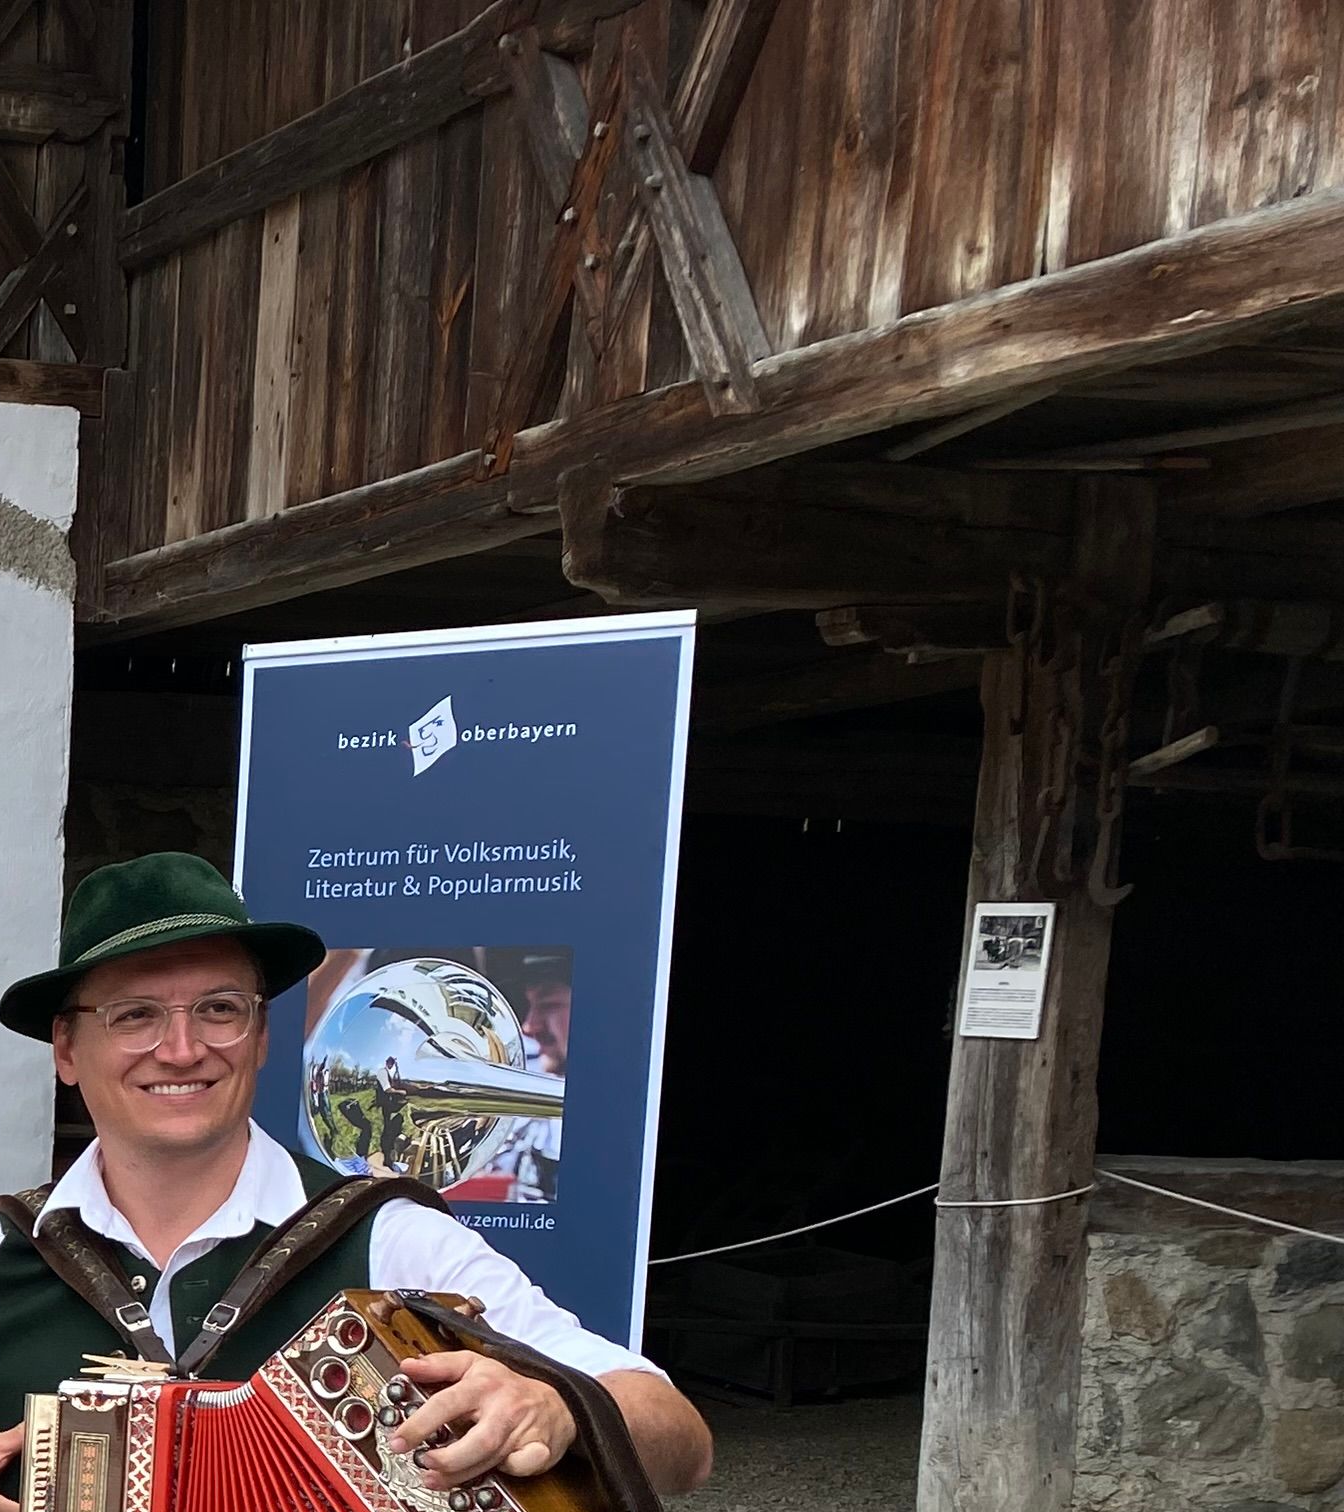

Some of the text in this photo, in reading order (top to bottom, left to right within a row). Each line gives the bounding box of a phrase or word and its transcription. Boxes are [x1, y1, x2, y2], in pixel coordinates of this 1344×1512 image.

[338, 722, 577, 750] bezirk oberbayern
[308, 838, 577, 868] Zentrum für Volksmusik,
[305, 870, 583, 900] Literatur & Popularmusik
